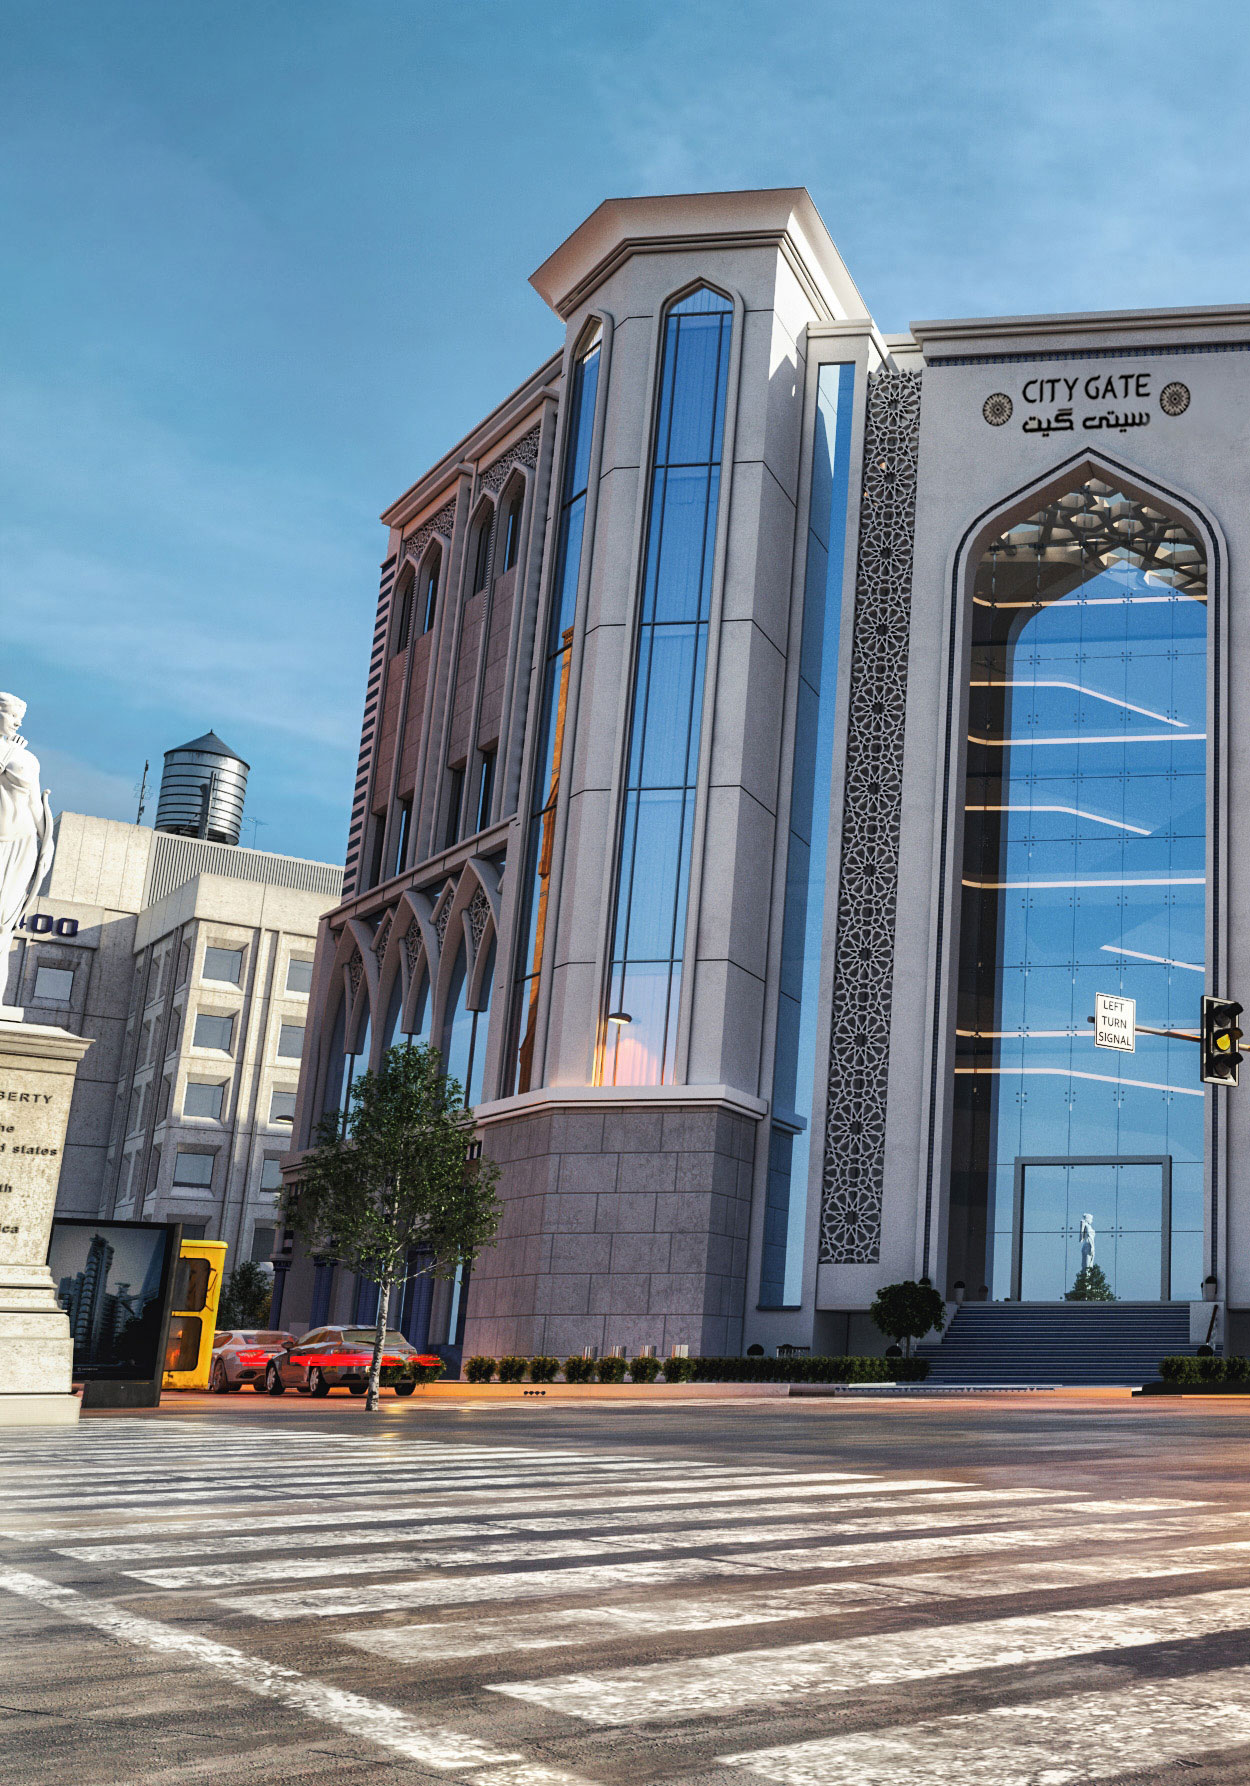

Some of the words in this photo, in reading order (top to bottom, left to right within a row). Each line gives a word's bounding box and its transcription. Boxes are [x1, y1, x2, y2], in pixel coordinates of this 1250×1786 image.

[1022, 377, 1079, 403] CITY
[1084, 373, 1151, 400] GATE
[1103, 1000, 1124, 1012] LEFT
[1101, 1015, 1127, 1029] TURN
[1098, 1031, 1132, 1046] SIGNAL
[12, 1145, 57, 1156] states
